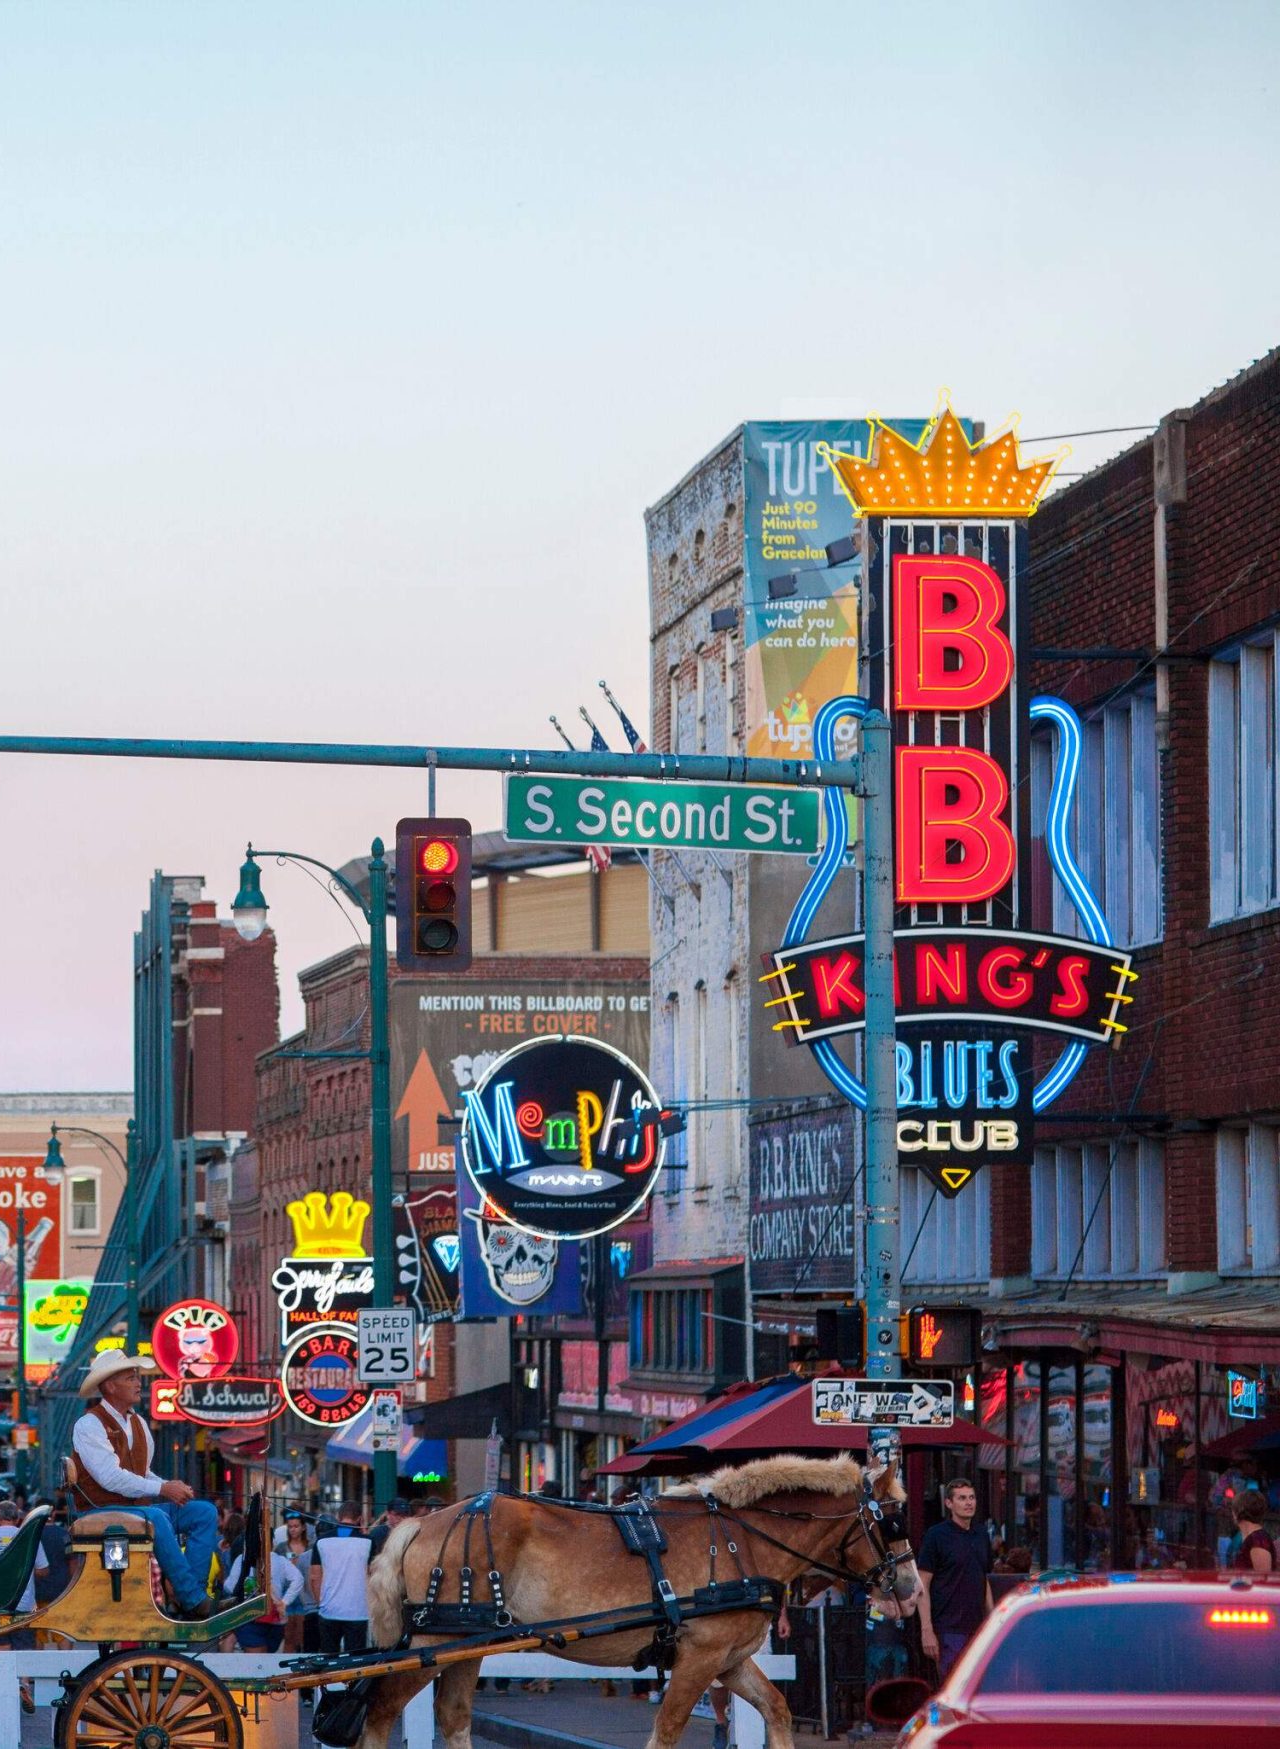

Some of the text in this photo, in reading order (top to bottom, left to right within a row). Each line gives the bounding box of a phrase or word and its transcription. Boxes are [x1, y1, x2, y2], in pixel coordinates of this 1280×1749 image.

[762, 441, 862, 496] TUPE
[762, 501, 817, 515] Just 90
[762, 517, 818, 530] Minutes
[762, 531, 796, 545] from
[762, 545, 827, 560] Gracelan
[765, 615, 835, 632] what you
[765, 632, 857, 648] can do here
[764, 710, 857, 752] tupo
[524, 785, 802, 846] S. Second St.
[419, 995, 484, 1012] MENTION
[489, 995, 522, 1012] THIS
[527, 995, 603, 1012] BILLBOARD
[608, 995, 625, 1012] TO
[479, 1014, 597, 1034] FREE COVER
[895, 1040, 1019, 1109] BLUES
[460, 1078, 657, 1177] Memphis
[896, 1119, 1019, 1153] CLUB
[34, 1165, 46, 1179] a
[424, 1206, 456, 1218] BLA
[750, 1203, 854, 1262] COMPANY STORE
[163, 1305, 228, 1332] PIG
[289, 1311, 358, 1322] HALL OF FA
[362, 1316, 410, 1329] SPEED
[308, 1335, 353, 1357] BAR
[367, 1332, 404, 1344] LIMIT
[363, 1347, 410, 1374] 25
[28, 1367, 50, 1378] FOO
[293, 1392, 367, 1423] 159 BEALE
